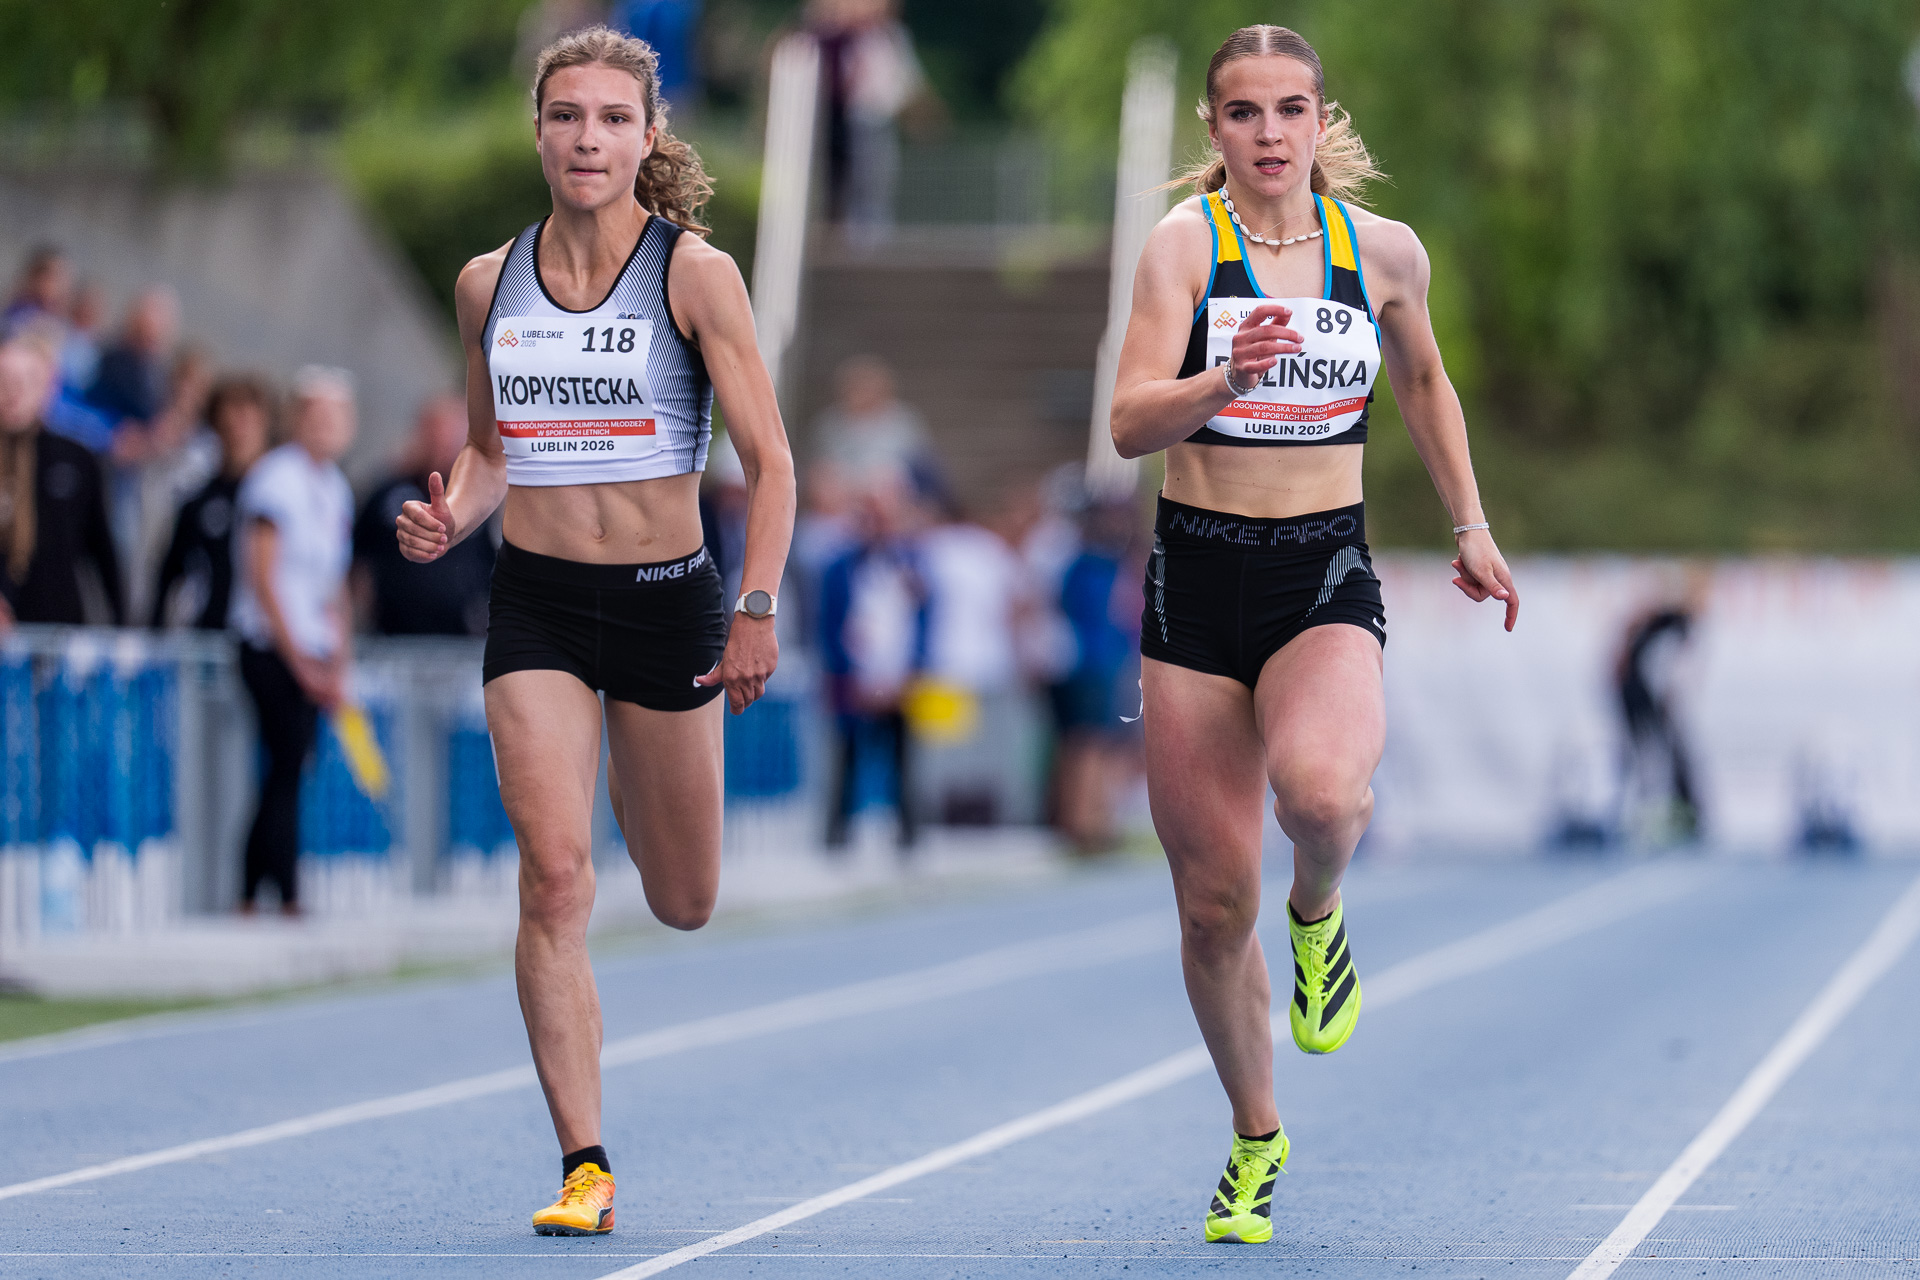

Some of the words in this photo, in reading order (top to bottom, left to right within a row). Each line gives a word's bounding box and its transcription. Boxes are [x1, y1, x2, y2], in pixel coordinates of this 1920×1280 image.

[1316, 307, 1352, 335] 89
[521, 330, 565, 339] LUBELSKIE
[581, 326, 636, 353] 118
[520, 339, 537, 348] 2026
[1214, 351, 1367, 389] LIŃSKA
[498, 375, 645, 406] KOPYSTECKA
[1233, 402, 1291, 413] OGÓLNOPOLSKA
[1291, 406, 1328, 414] OLIMPIADA
[1261, 411, 1300, 421] SPORTACH
[1300, 413, 1328, 421] LETNICH
[518, 421, 573, 430] OGÓLNOPOLSKA
[573, 421, 610, 429] OLIMPIADA
[1244, 422, 1295, 435] LUBLIN
[1298, 422, 1331, 436] 2026
[545, 429, 582, 437] SPORTACH
[582, 428, 610, 436] LETNICH
[531, 441, 578, 453] LUBLIN
[580, 440, 615, 451] 2026
[1169, 511, 1267, 546] NIKE
[635, 562, 685, 582] NIKE
